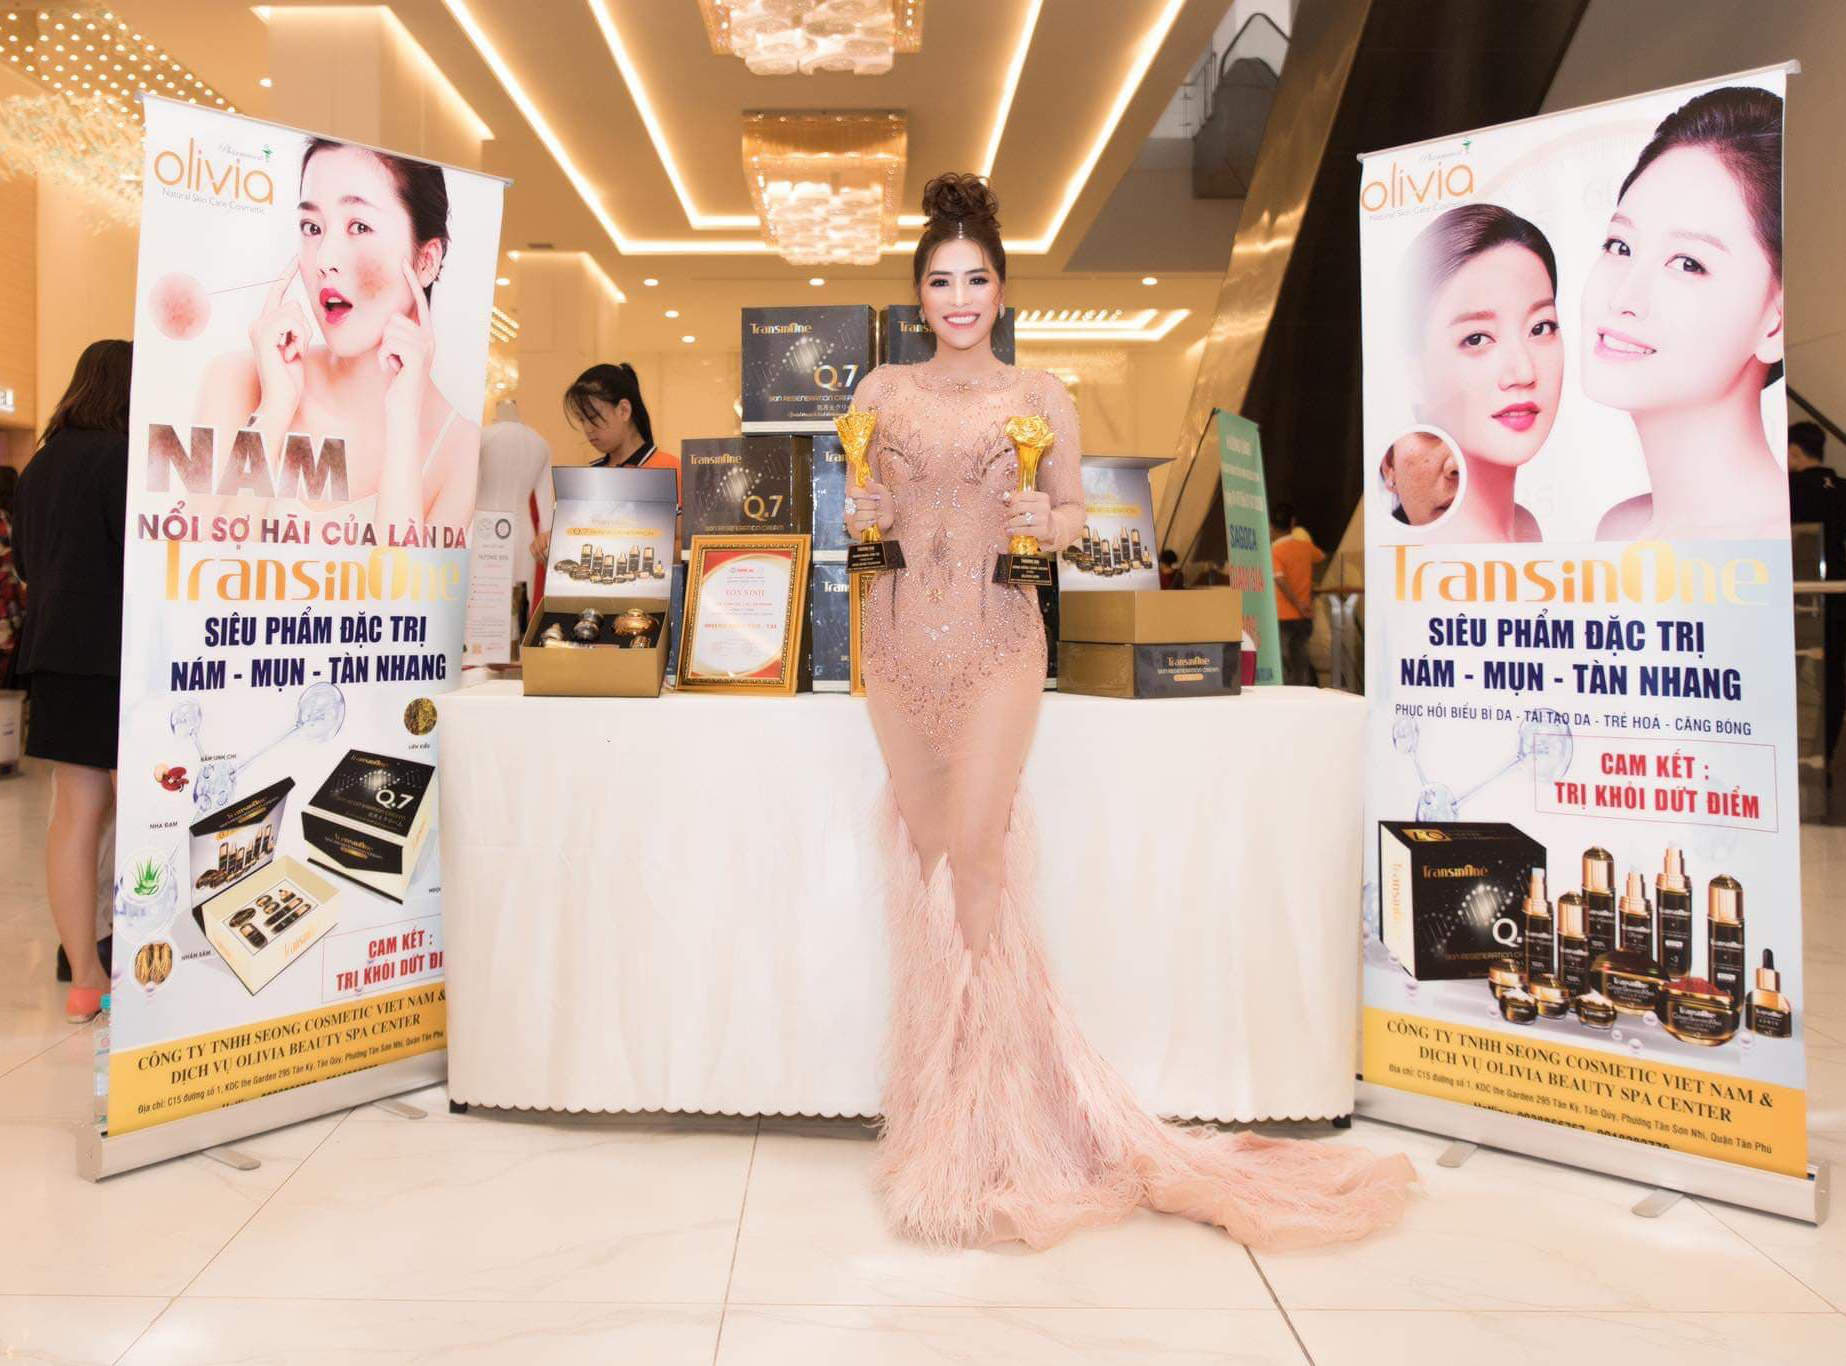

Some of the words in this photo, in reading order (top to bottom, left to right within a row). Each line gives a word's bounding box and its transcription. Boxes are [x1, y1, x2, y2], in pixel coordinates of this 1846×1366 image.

[154, 137, 274, 205] olivia
[1361, 161, 1474, 213] olivia
[897, 320, 933, 333] Trans
[813, 363, 859, 392] Q.7
[147, 415, 349, 502] NÁM
[138, 500, 199, 542] NỔI
[211, 514, 250, 550] SỢ
[261, 513, 311, 544] HÃI
[321, 513, 377, 546] CỦA
[388, 517, 437, 549] LÀN
[443, 525, 467, 549] DA
[743, 494, 783, 522] Q.7
[146, 540, 462, 601] TransinOne
[821, 580, 849, 593] Tran
[1379, 539, 1770, 606] TransinOne
[204, 611, 257, 648] SIÊU
[265, 606, 332, 645] PHẨM
[339, 611, 382, 649] ĐẶC
[390, 615, 427, 648] TRỊ
[1428, 612, 1487, 648] SIÊU
[1497, 608, 1574, 649] PHẨM
[1584, 614, 1646, 657] ĐẶC
[1656, 620, 1705, 659] TRỊ
[170, 656, 226, 692] NÁM
[250, 657, 306, 693] MỤN
[328, 652, 369, 685] TÀN
[376, 653, 447, 682] NHANG
[1400, 654, 1455, 688] NÁM
[1483, 660, 1544, 697] MỤN
[1572, 659, 1627, 696] TÀN
[1639, 665, 1742, 702] NHANG
[1395, 703, 1423, 719] PHỤC
[1496, 708, 1512, 721] DA
[1574, 712, 1591, 726] DA
[1675, 716, 1711, 733] CĂNG
[1716, 718, 1752, 736] BÓNG
[1600, 752, 1647, 777] CAM
[1656, 748, 1695, 779] KẾT
[1704, 764, 1709, 781] :
[375, 789, 414, 810] Q.7
[1554, 781, 1586, 810] TRỊ
[1595, 780, 1645, 810] KHỎI
[1654, 785, 1697, 813] DỨT
[1706, 785, 1760, 819] ĐIỂM
[368, 936, 397, 959] CAM
[402, 925, 425, 951] KẾT
[1492, 917, 1523, 948] Q.
[336, 970, 359, 992] TRỊ
[428, 951, 444, 970] ĐI
[138, 1050, 182, 1071] CÔNG
[187, 1043, 206, 1060] TY
[210, 1032, 251, 1054] TNHH
[254, 1022, 301, 1044] SEONG
[305, 1004, 373, 1033] COSMETIC
[377, 998, 404, 1014] VIET
[407, 991, 434, 1008] NAM
[171, 1064, 208, 1085] DỊCH
[213, 1057, 233, 1075] VỤ
[236, 1046, 285, 1067] OLIVIA
[290, 1031, 342, 1055] BEAUTY
[345, 1026, 367, 1041] SPA
[371, 1013, 421, 1035] CENTER
[1387, 1018, 1429, 1039] CÔNG
[1433, 1028, 1453, 1044] TY
[1457, 1033, 1502, 1054] TNHH
[1505, 1043, 1560, 1066] SEONG
[1566, 1054, 1658, 1085] COSMETIC
[1662, 1072, 1705, 1094] VIET
[1710, 1082, 1753, 1104] NAM
[1759, 1092, 1773, 1108] &
[167, 1097, 181, 1107] C15
[225, 1081, 239, 1092] KDC
[240, 1078, 252, 1088] the
[253, 1072, 276, 1085] Garden
[278, 1066, 290, 1079] 295
[1417, 1070, 1431, 1080] C15
[1475, 1082, 1491, 1094] KDC
[1492, 1085, 1505, 1096] the
[1506, 1088, 1534, 1103] Garden
[1536, 1094, 1550, 1106] 295
[1419, 1046, 1457, 1066] DỊCH
[1461, 1053, 1482, 1074] VỤ
[1486, 1060, 1543, 1083] OLIVIA
[1548, 1071, 1616, 1098] BEAUTY
[1620, 1087, 1653, 1107] SPA
[1657, 1094, 1732, 1122] CENTER
